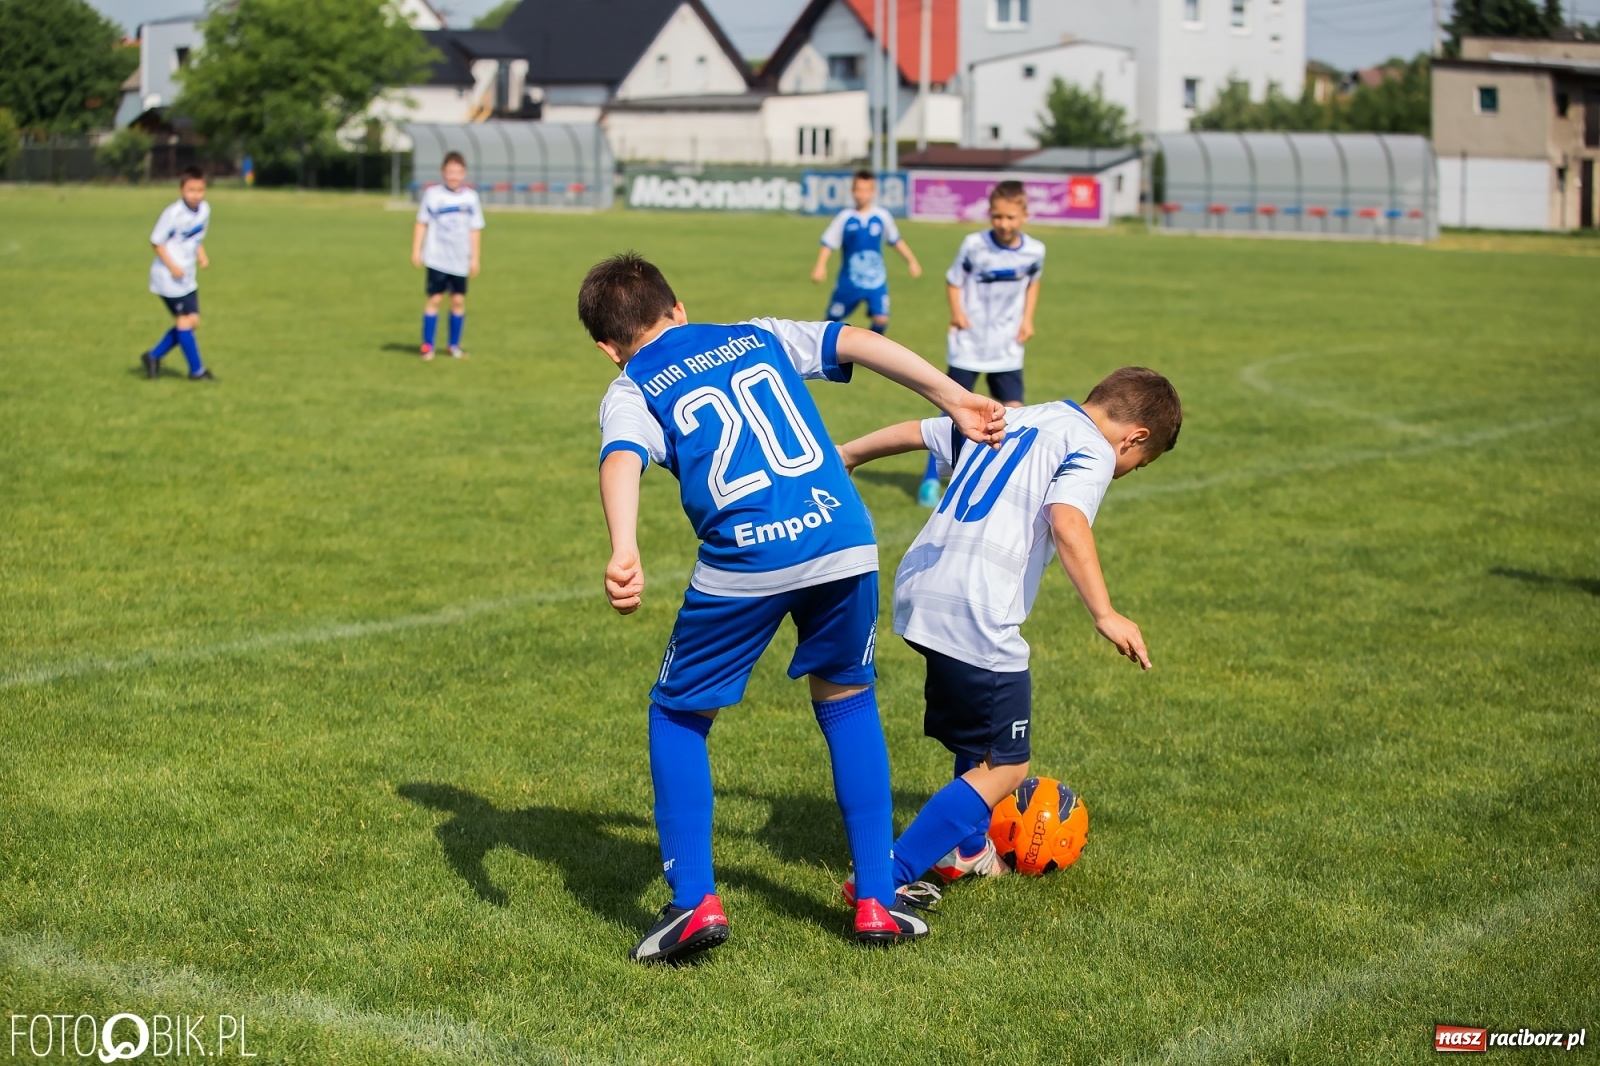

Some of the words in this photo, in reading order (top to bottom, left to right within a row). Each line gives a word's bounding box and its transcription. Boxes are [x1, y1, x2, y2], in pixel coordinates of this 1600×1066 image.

[629, 174, 803, 211] McDonald's
[643, 364, 687, 397] UNIA
[683, 334, 766, 375] RACIBÓRZ
[673, 362, 824, 511] 20
[936, 425, 1039, 523] 10
[733, 501, 834, 548] Empor
[1024, 810, 1051, 866] Kappa
